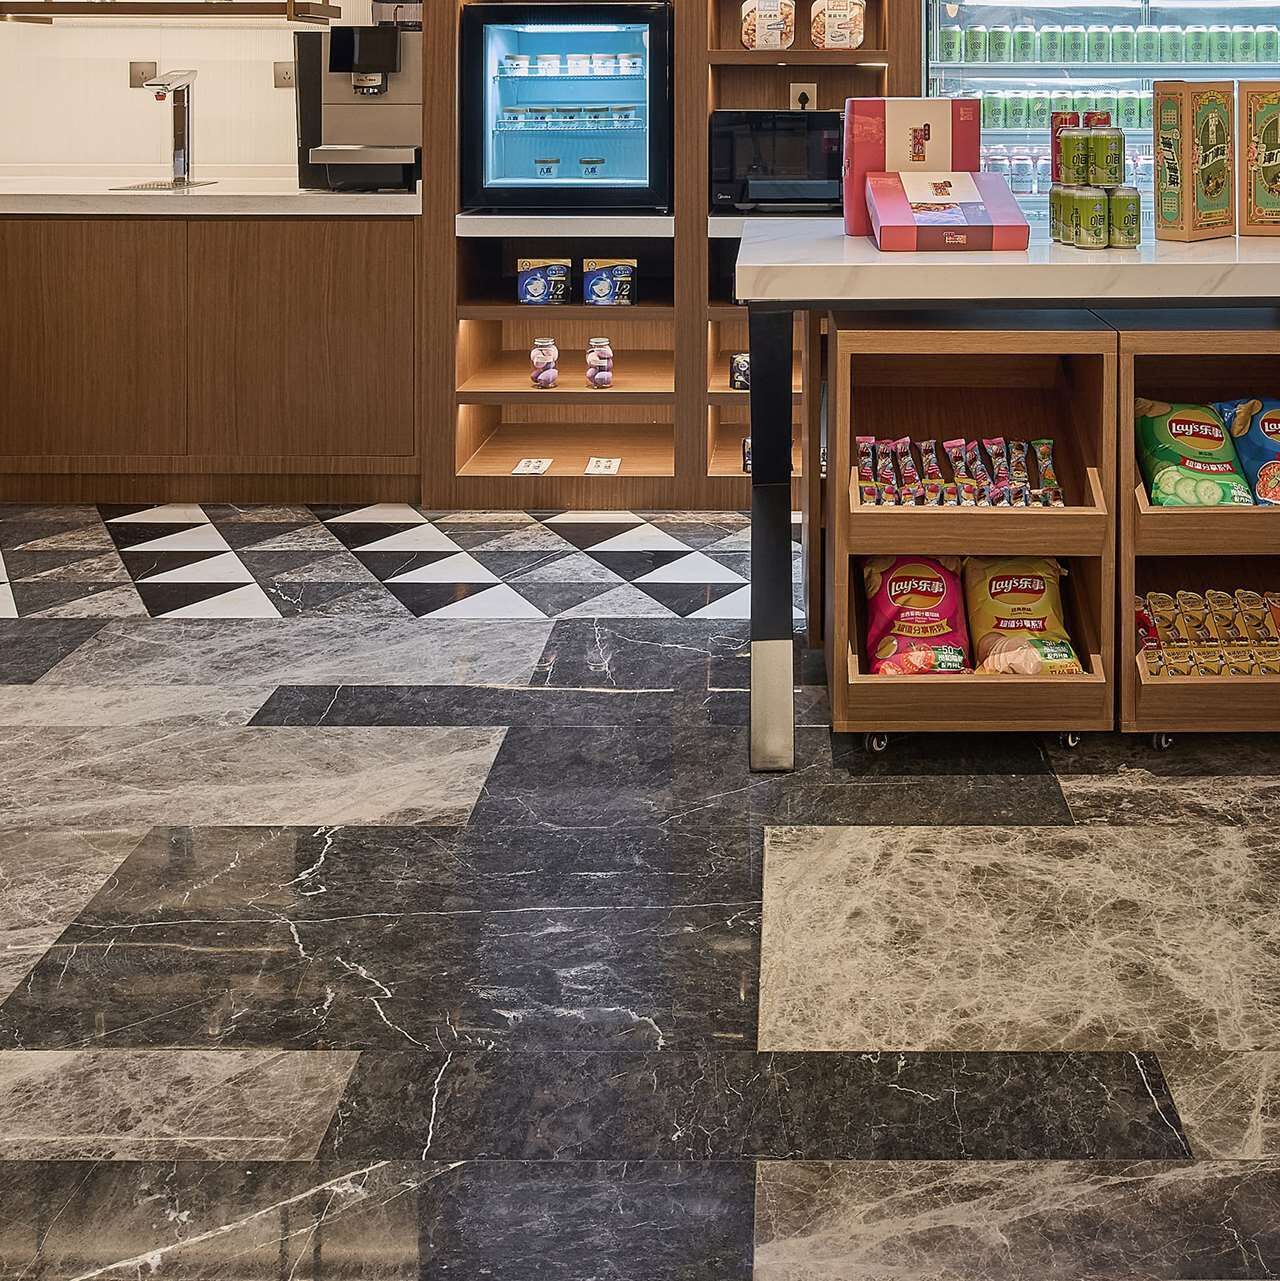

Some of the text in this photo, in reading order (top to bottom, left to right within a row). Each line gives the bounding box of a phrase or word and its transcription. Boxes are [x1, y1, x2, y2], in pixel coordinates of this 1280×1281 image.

[1171, 422, 1199, 436] Lay's
[1199, 424, 1223, 438] 乐事
[891, 578, 918, 597] Lay's
[918, 579, 944, 593] 乐事
[990, 577, 1019, 593] Lay's
[1018, 577, 1044, 591] 乐事
